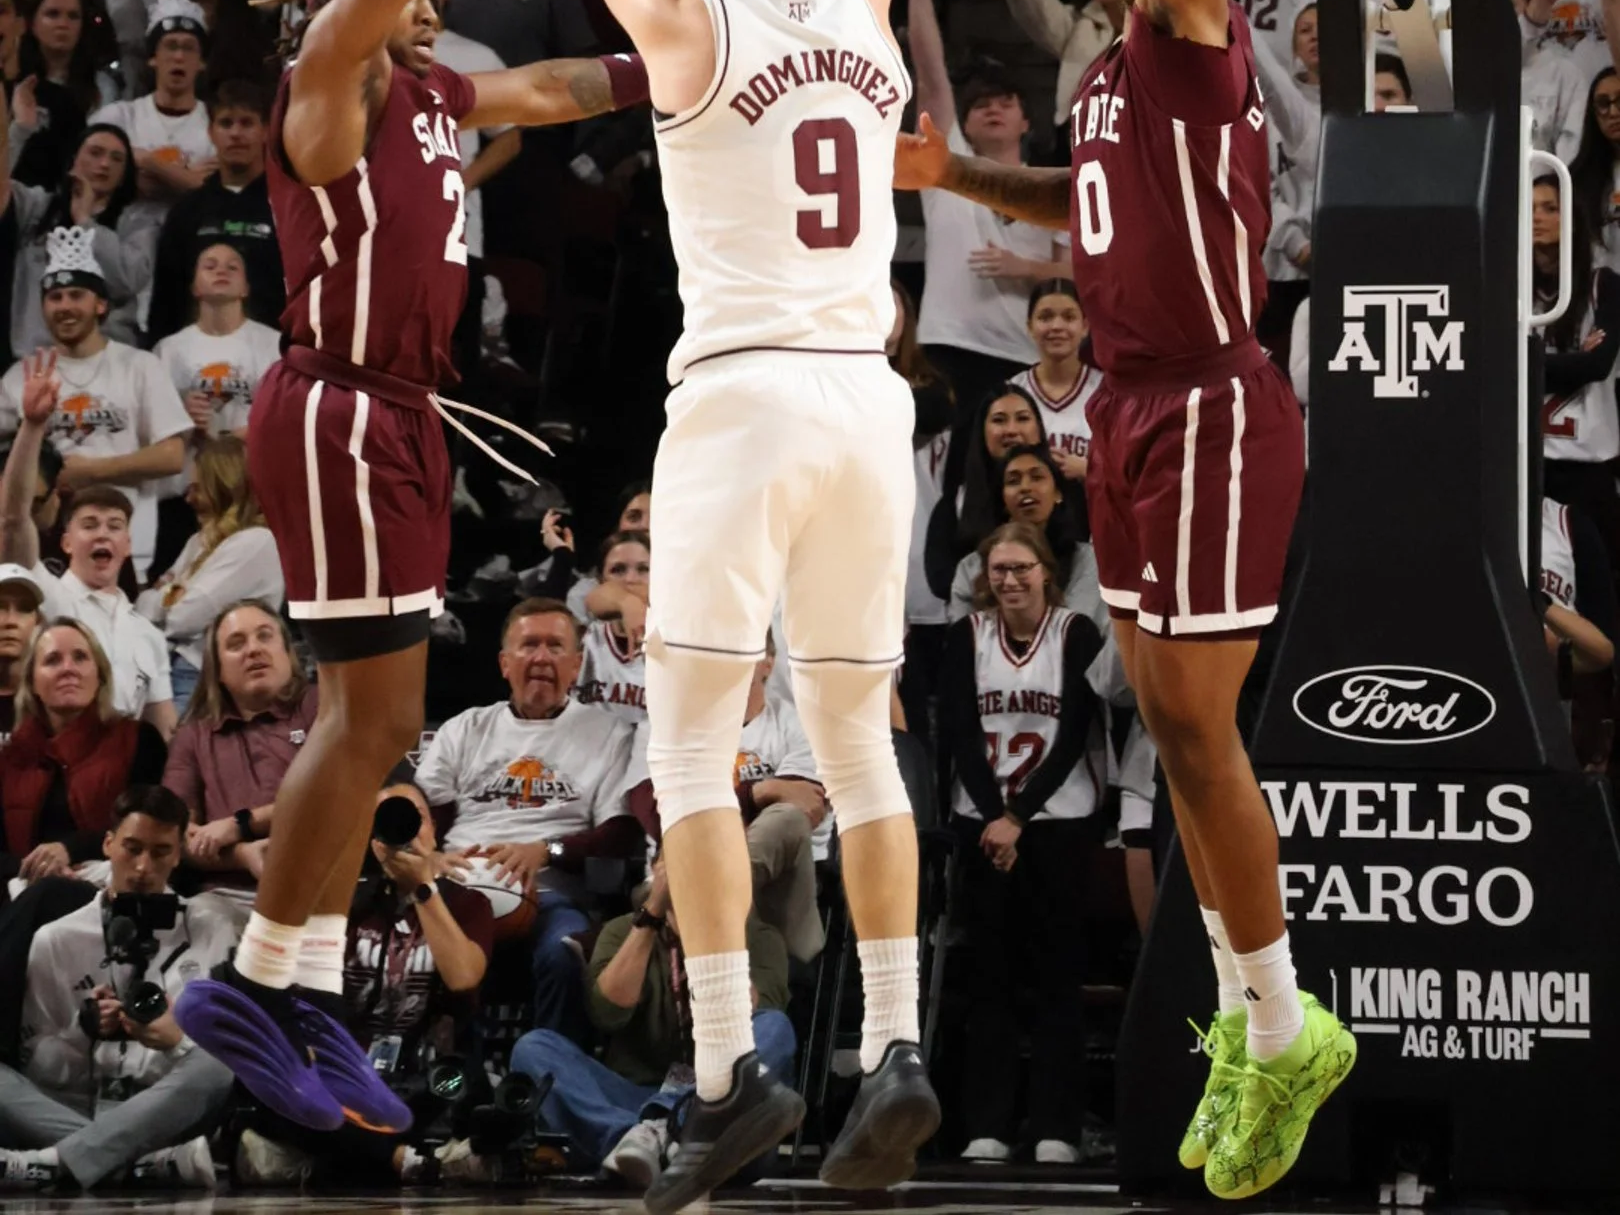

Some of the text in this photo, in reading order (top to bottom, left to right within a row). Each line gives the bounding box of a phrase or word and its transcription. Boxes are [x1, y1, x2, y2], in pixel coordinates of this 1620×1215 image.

[729, 49, 900, 126] DOMINGUEZ
[792, 117, 860, 249] 9
[1077, 160, 1113, 255] 0
[443, 169, 468, 265] 2
[1328, 674, 1461, 731] Ford
[1260, 781, 1533, 843] WELLS
[1278, 864, 1534, 927] FARGO
[1351, 967, 1590, 1024] KING RANCH
[1401, 1025, 1536, 1061] AG & TURF
